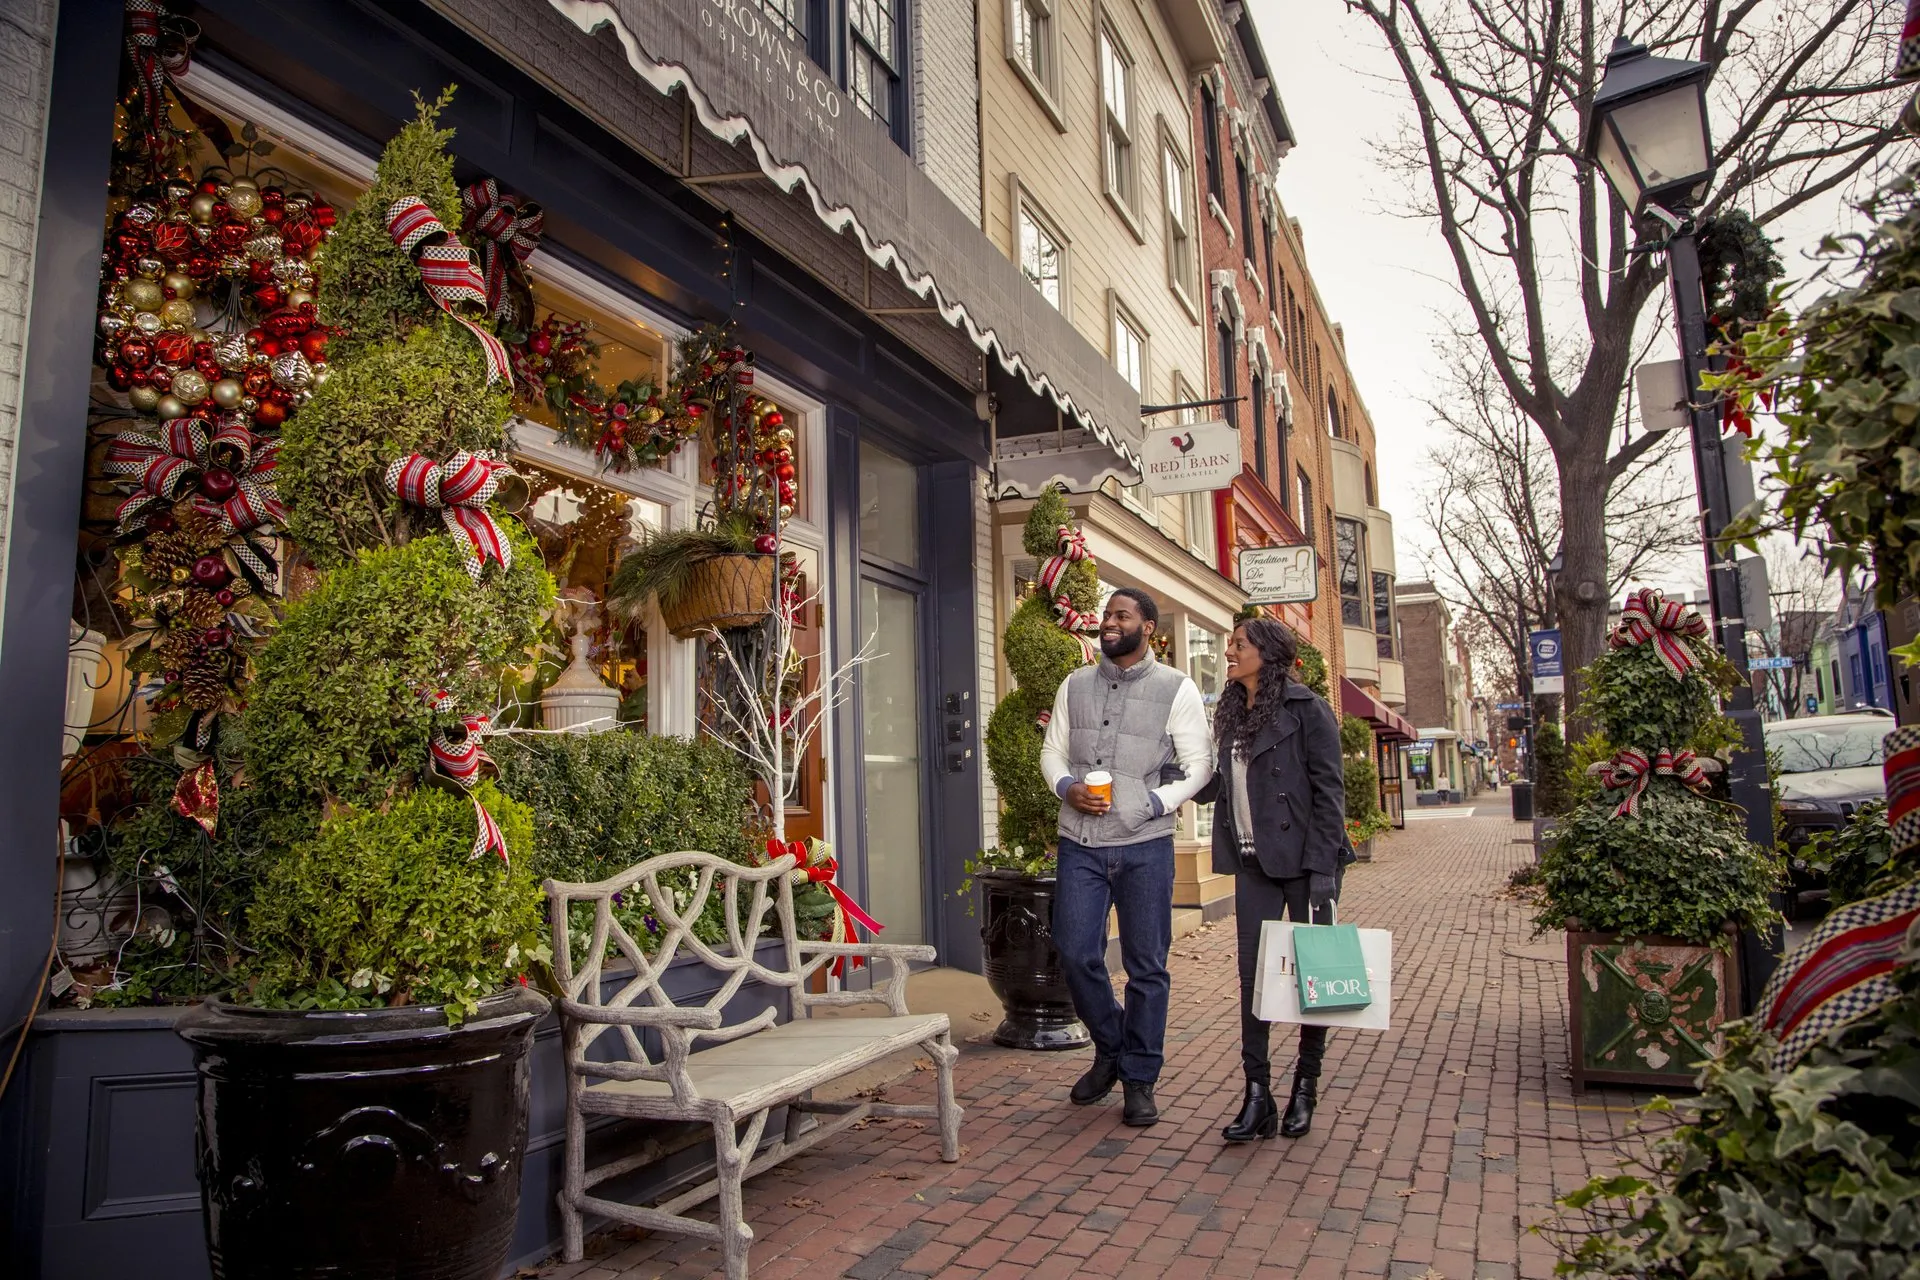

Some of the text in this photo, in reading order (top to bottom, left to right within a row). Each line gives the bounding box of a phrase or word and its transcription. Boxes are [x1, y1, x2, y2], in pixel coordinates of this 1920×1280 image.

[702, 8, 773, 83] OBJETS
[796, 60, 811, 94] &
[814, 78, 840, 118] CO
[1150, 454, 1231, 474] RED BARN
[1161, 469, 1218, 480] MERCANTILE
[1245, 553, 1288, 566] Tradition
[1245, 566, 1264, 580] De
[1247, 581, 1282, 593] France
[1750, 658, 1774, 669] HENRY
[1326, 979, 1368, 997] HOUR
